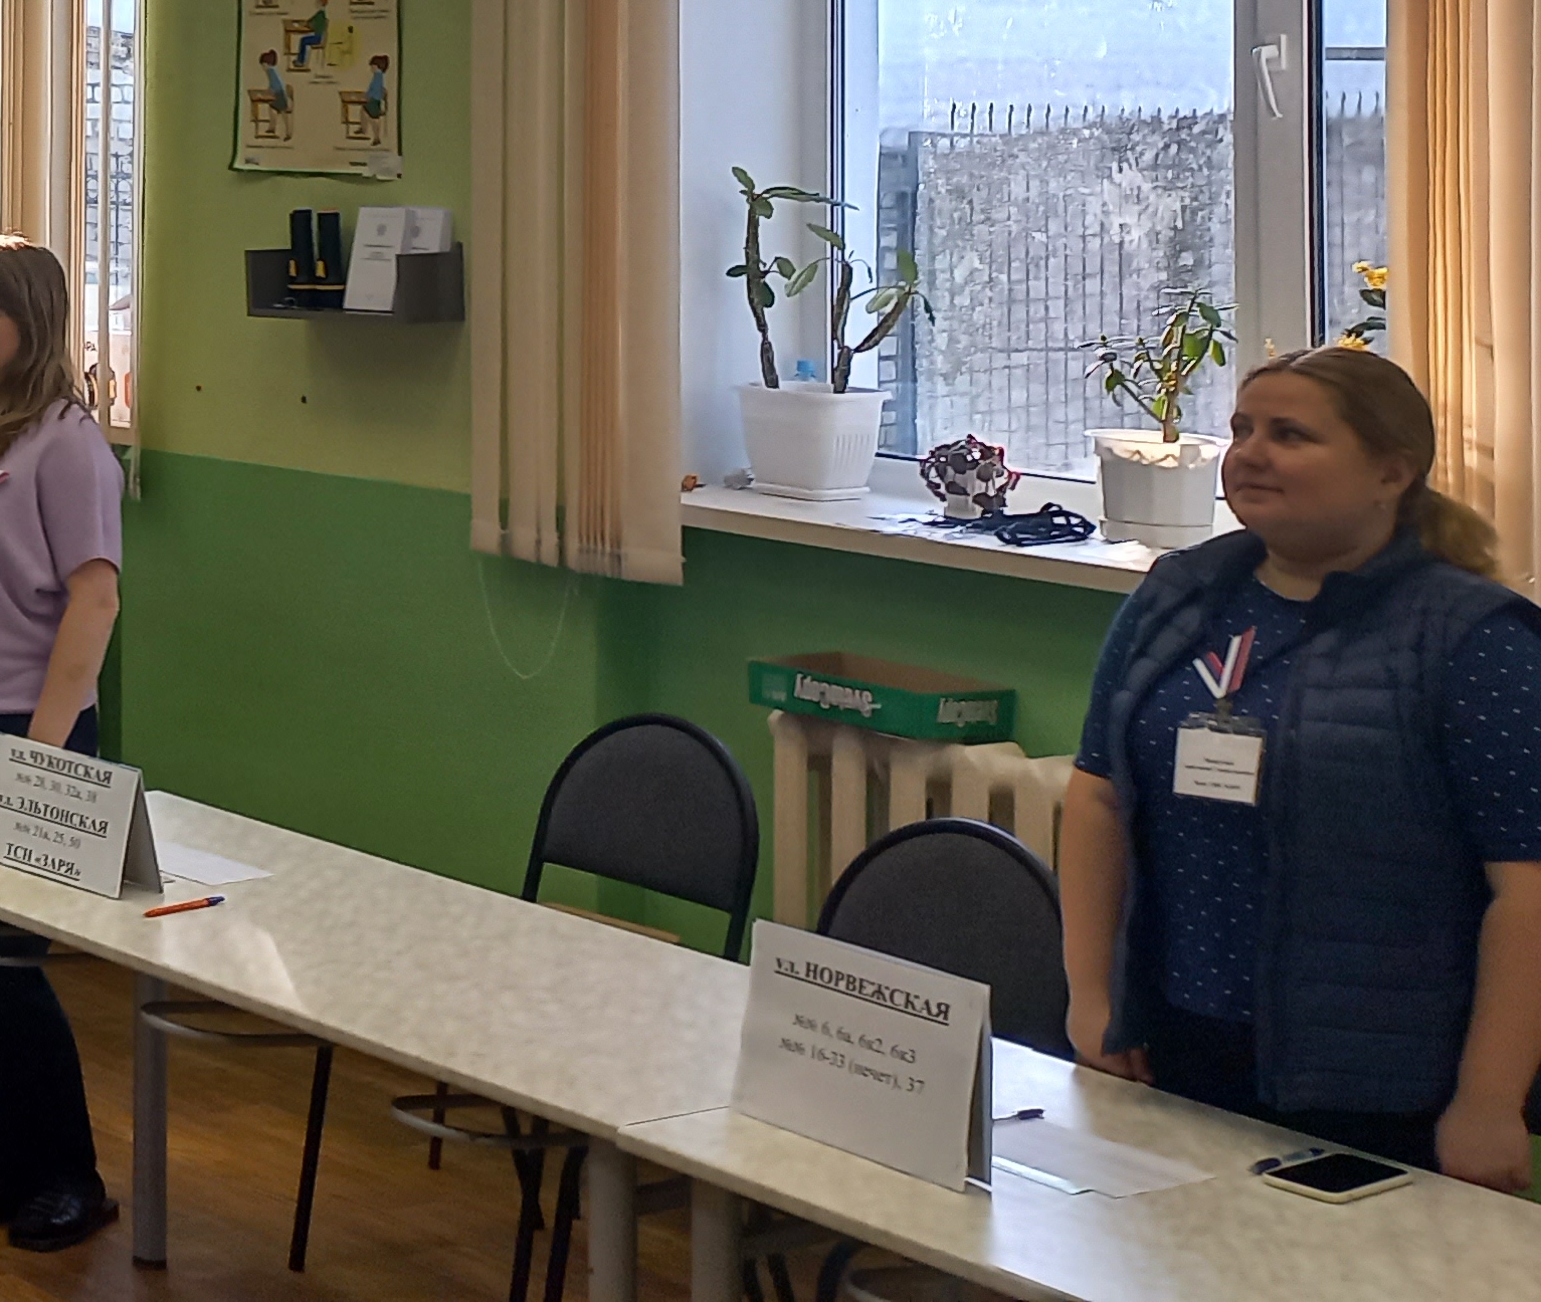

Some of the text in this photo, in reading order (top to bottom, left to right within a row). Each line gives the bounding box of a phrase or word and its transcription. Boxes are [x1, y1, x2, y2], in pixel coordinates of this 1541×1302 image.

[29, 750, 113, 785] ЧУКОТСКАЯ
[17, 796, 109, 834] ЭЛЬТОНСКАЯ
[6, 842, 82, 877] ТСН «ЗАРЯ»
[774, 957, 951, 1022] ул. НОРВЕЖСКАЯ
[906, 1076, 925, 1095] 37
